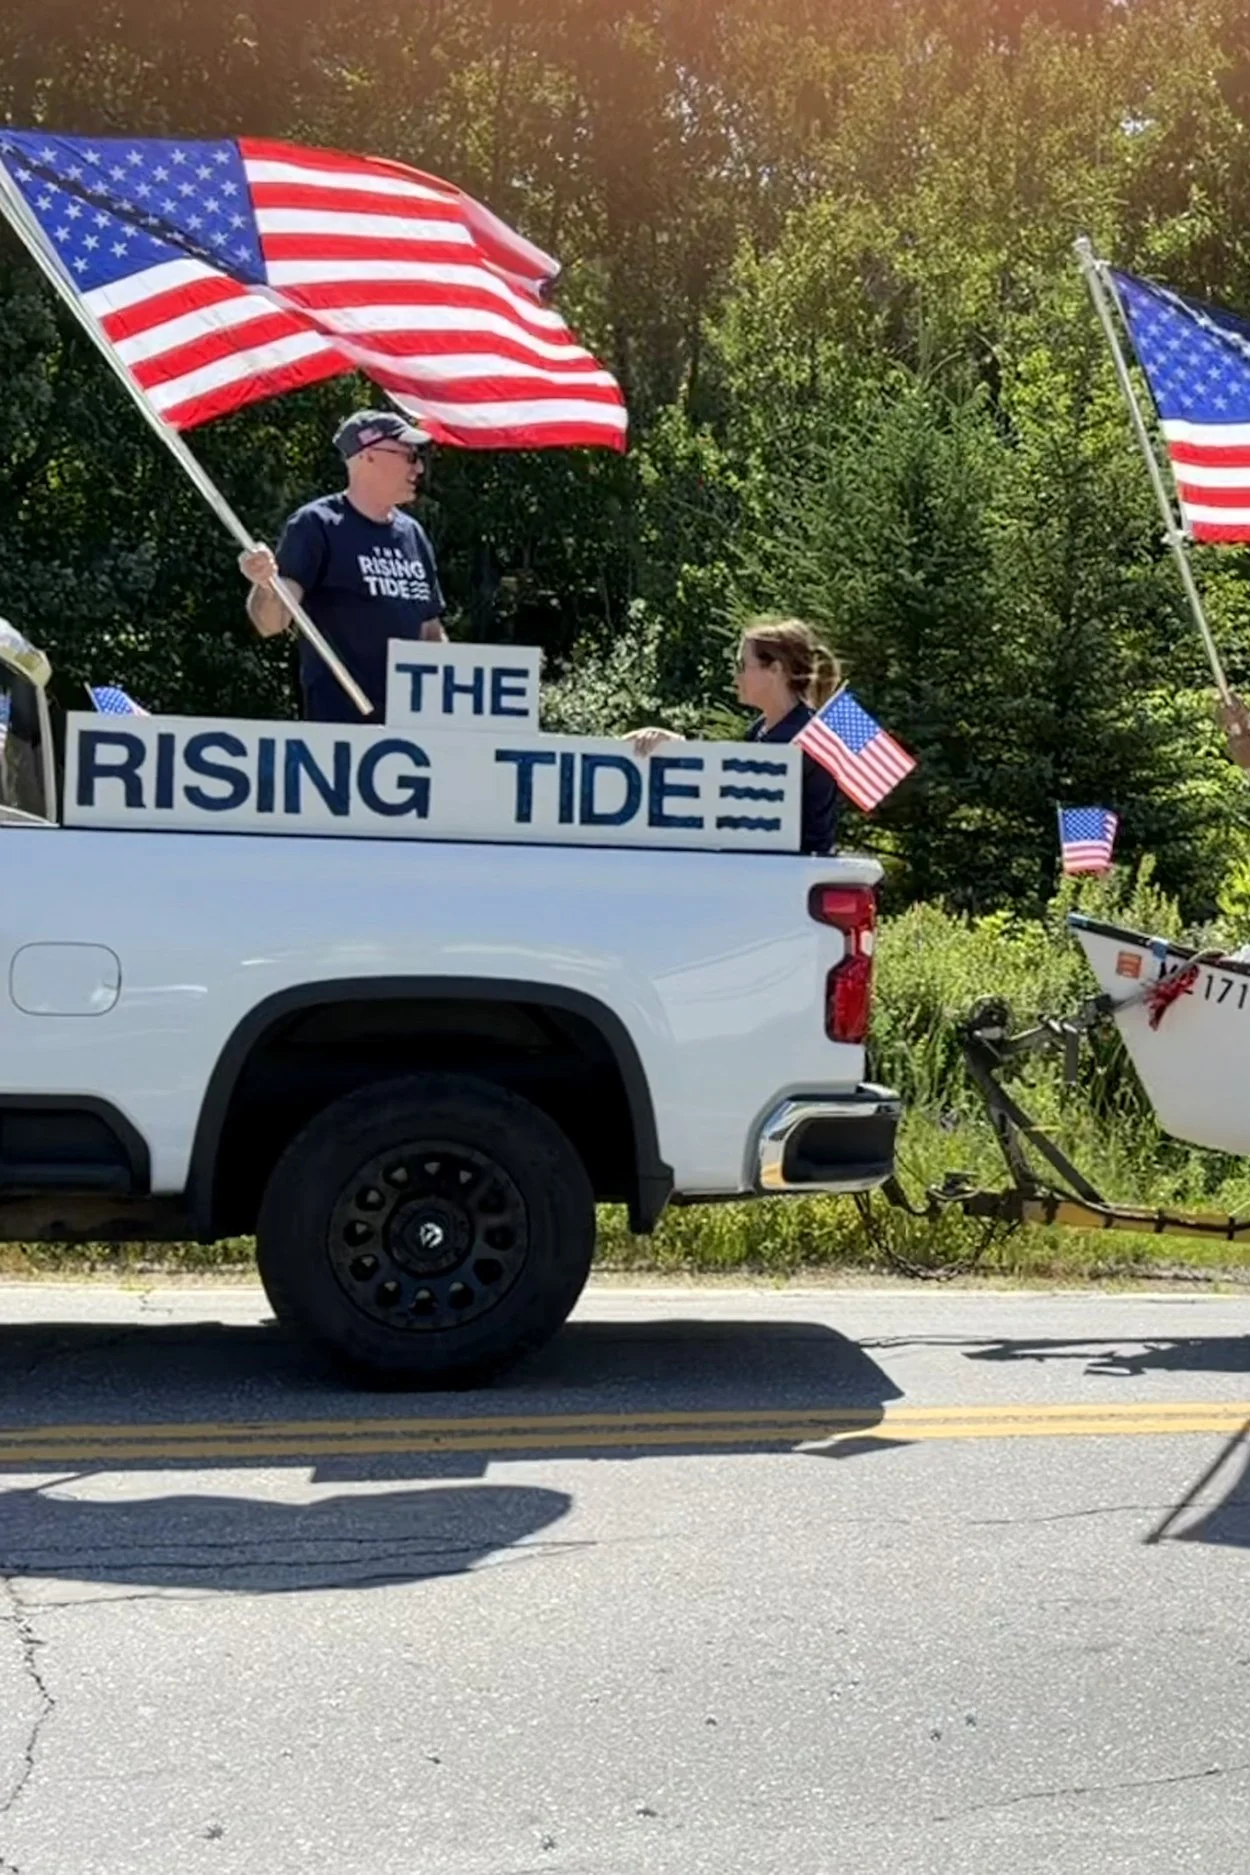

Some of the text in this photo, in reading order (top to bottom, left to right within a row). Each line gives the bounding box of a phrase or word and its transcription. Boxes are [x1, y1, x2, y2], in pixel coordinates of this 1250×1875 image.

[357, 555, 426, 580] RISING
[363, 576, 410, 599] TIDE
[394, 662, 530, 717] THE
[76, 729, 705, 830] RISING TIDE
